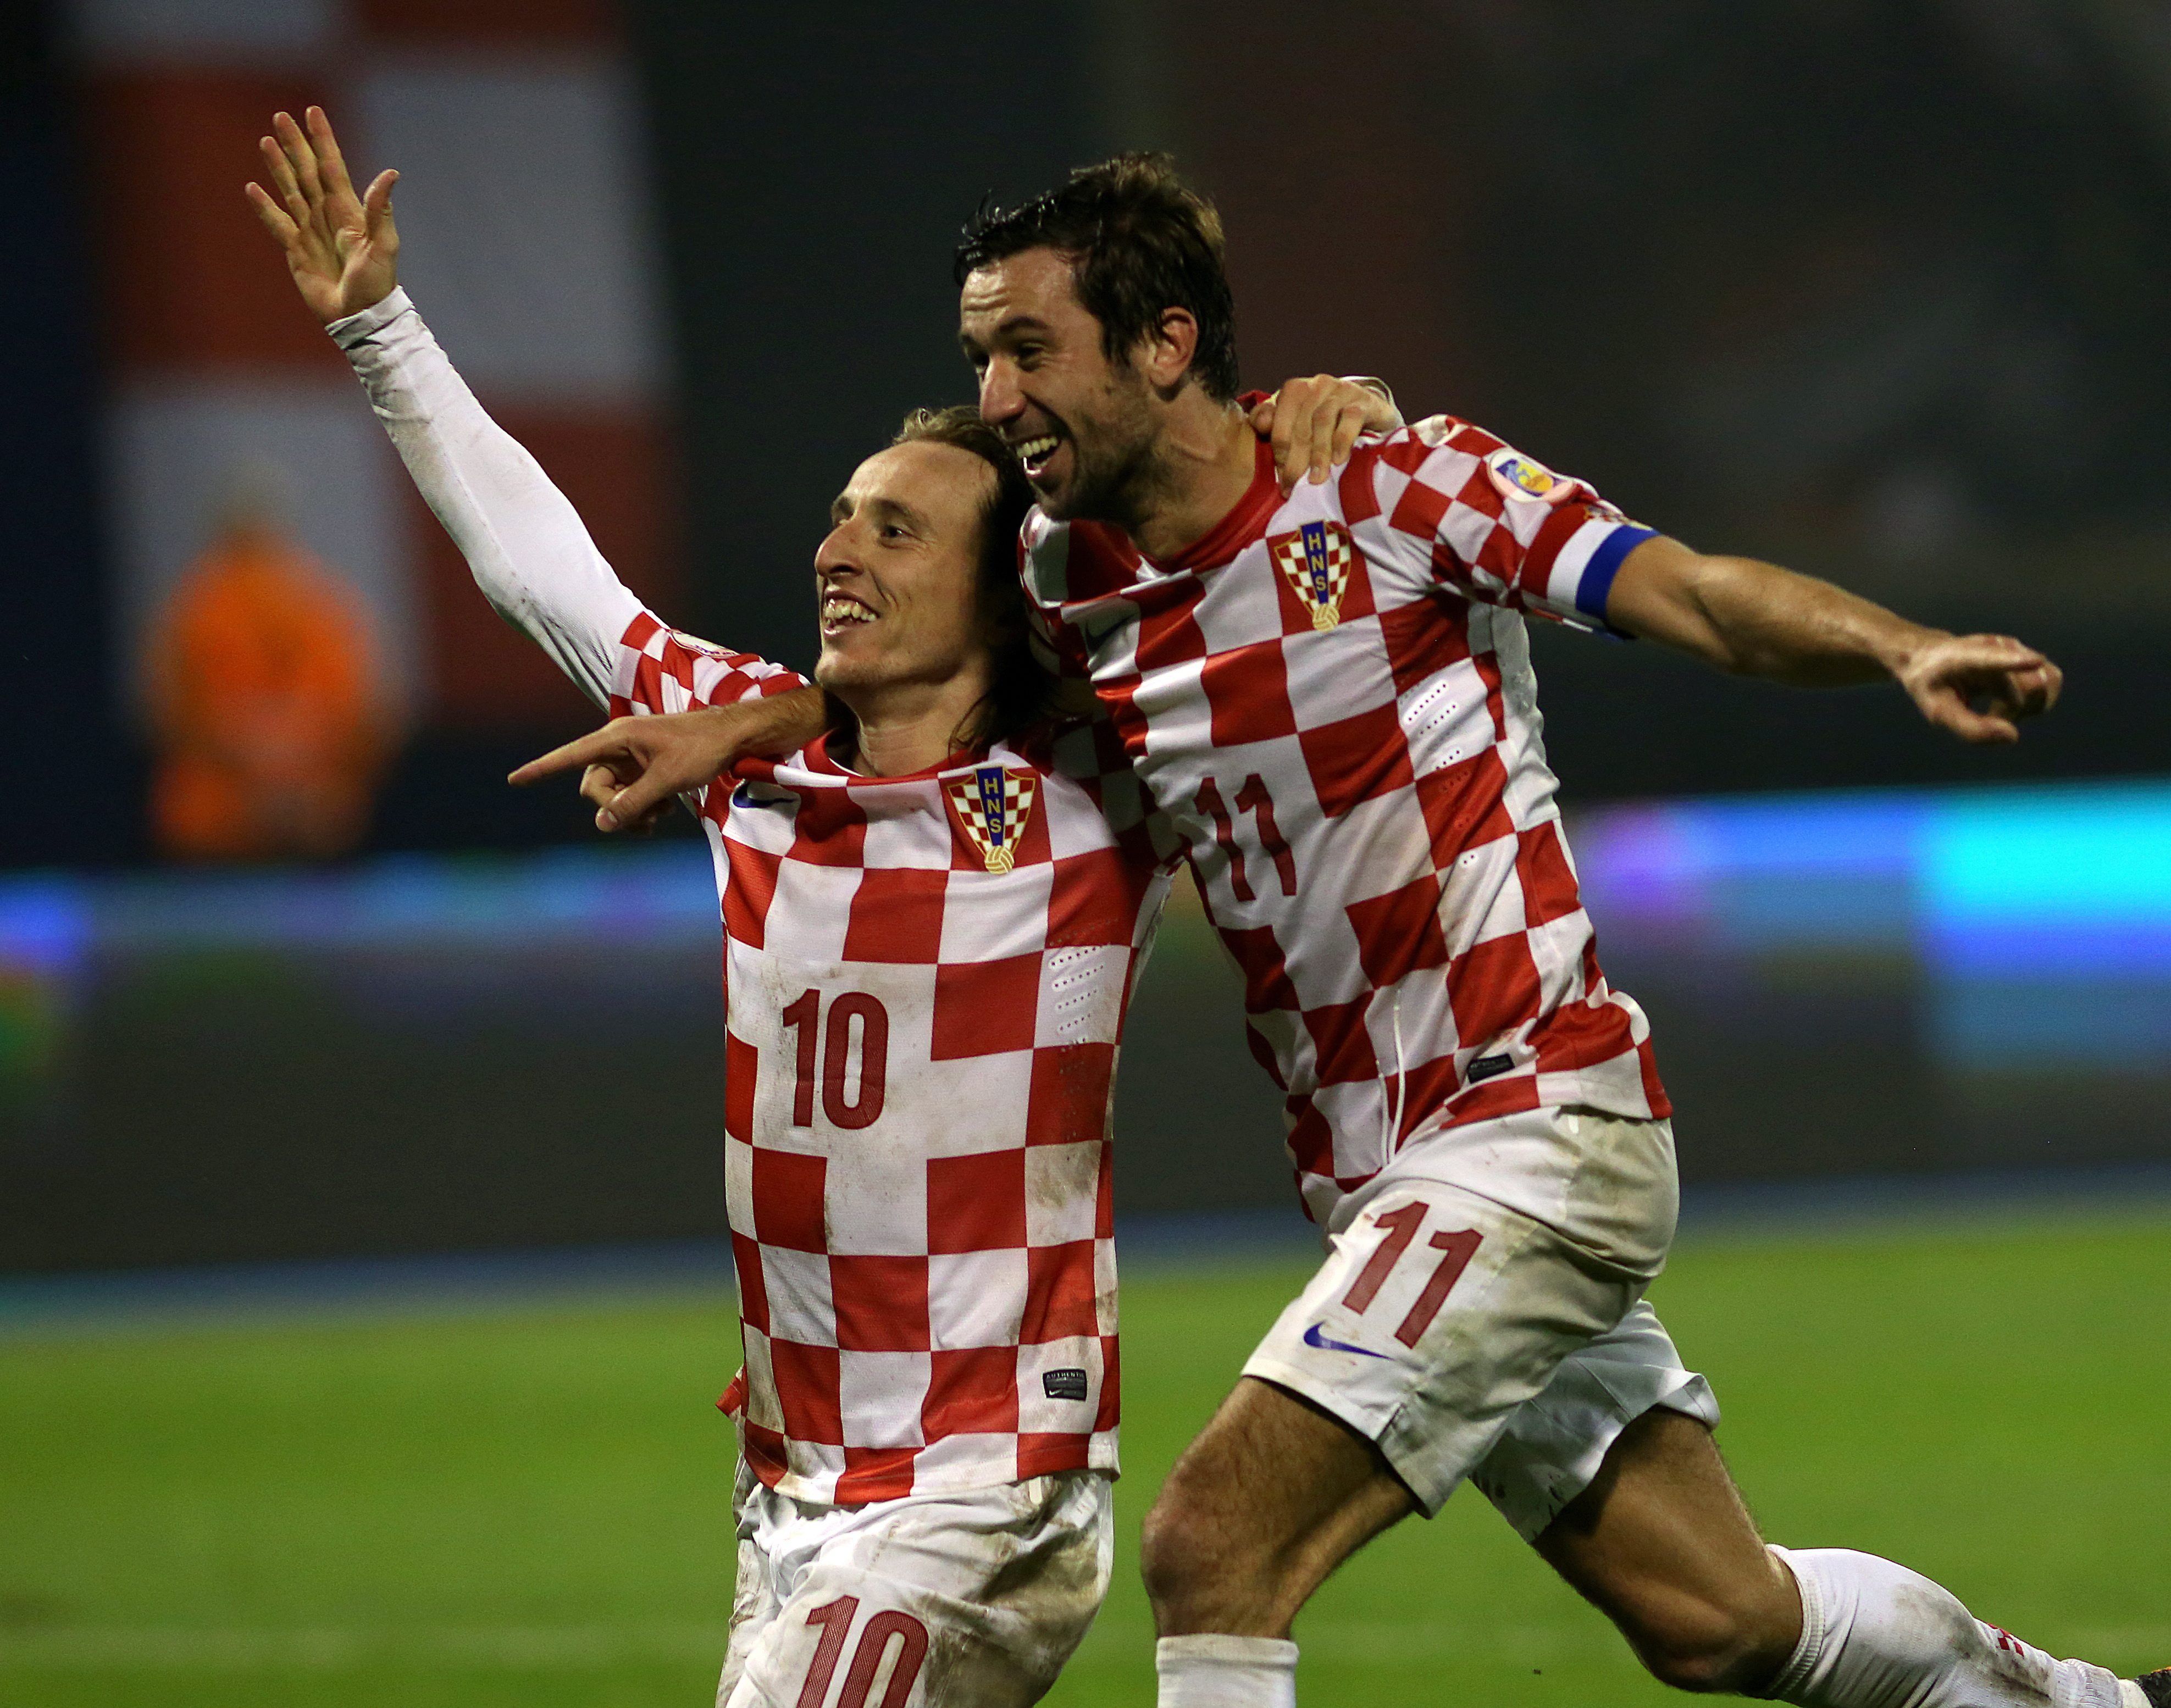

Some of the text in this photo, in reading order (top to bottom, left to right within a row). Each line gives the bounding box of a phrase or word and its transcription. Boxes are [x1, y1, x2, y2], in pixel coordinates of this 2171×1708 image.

[1308, 533, 1326, 591] HNS
[983, 778, 1002, 834] HNS
[1193, 773, 1297, 902] 11
[783, 988, 889, 1129] 10
[1342, 1201, 1483, 1349] 11
[796, 1595, 929, 1708] 10
